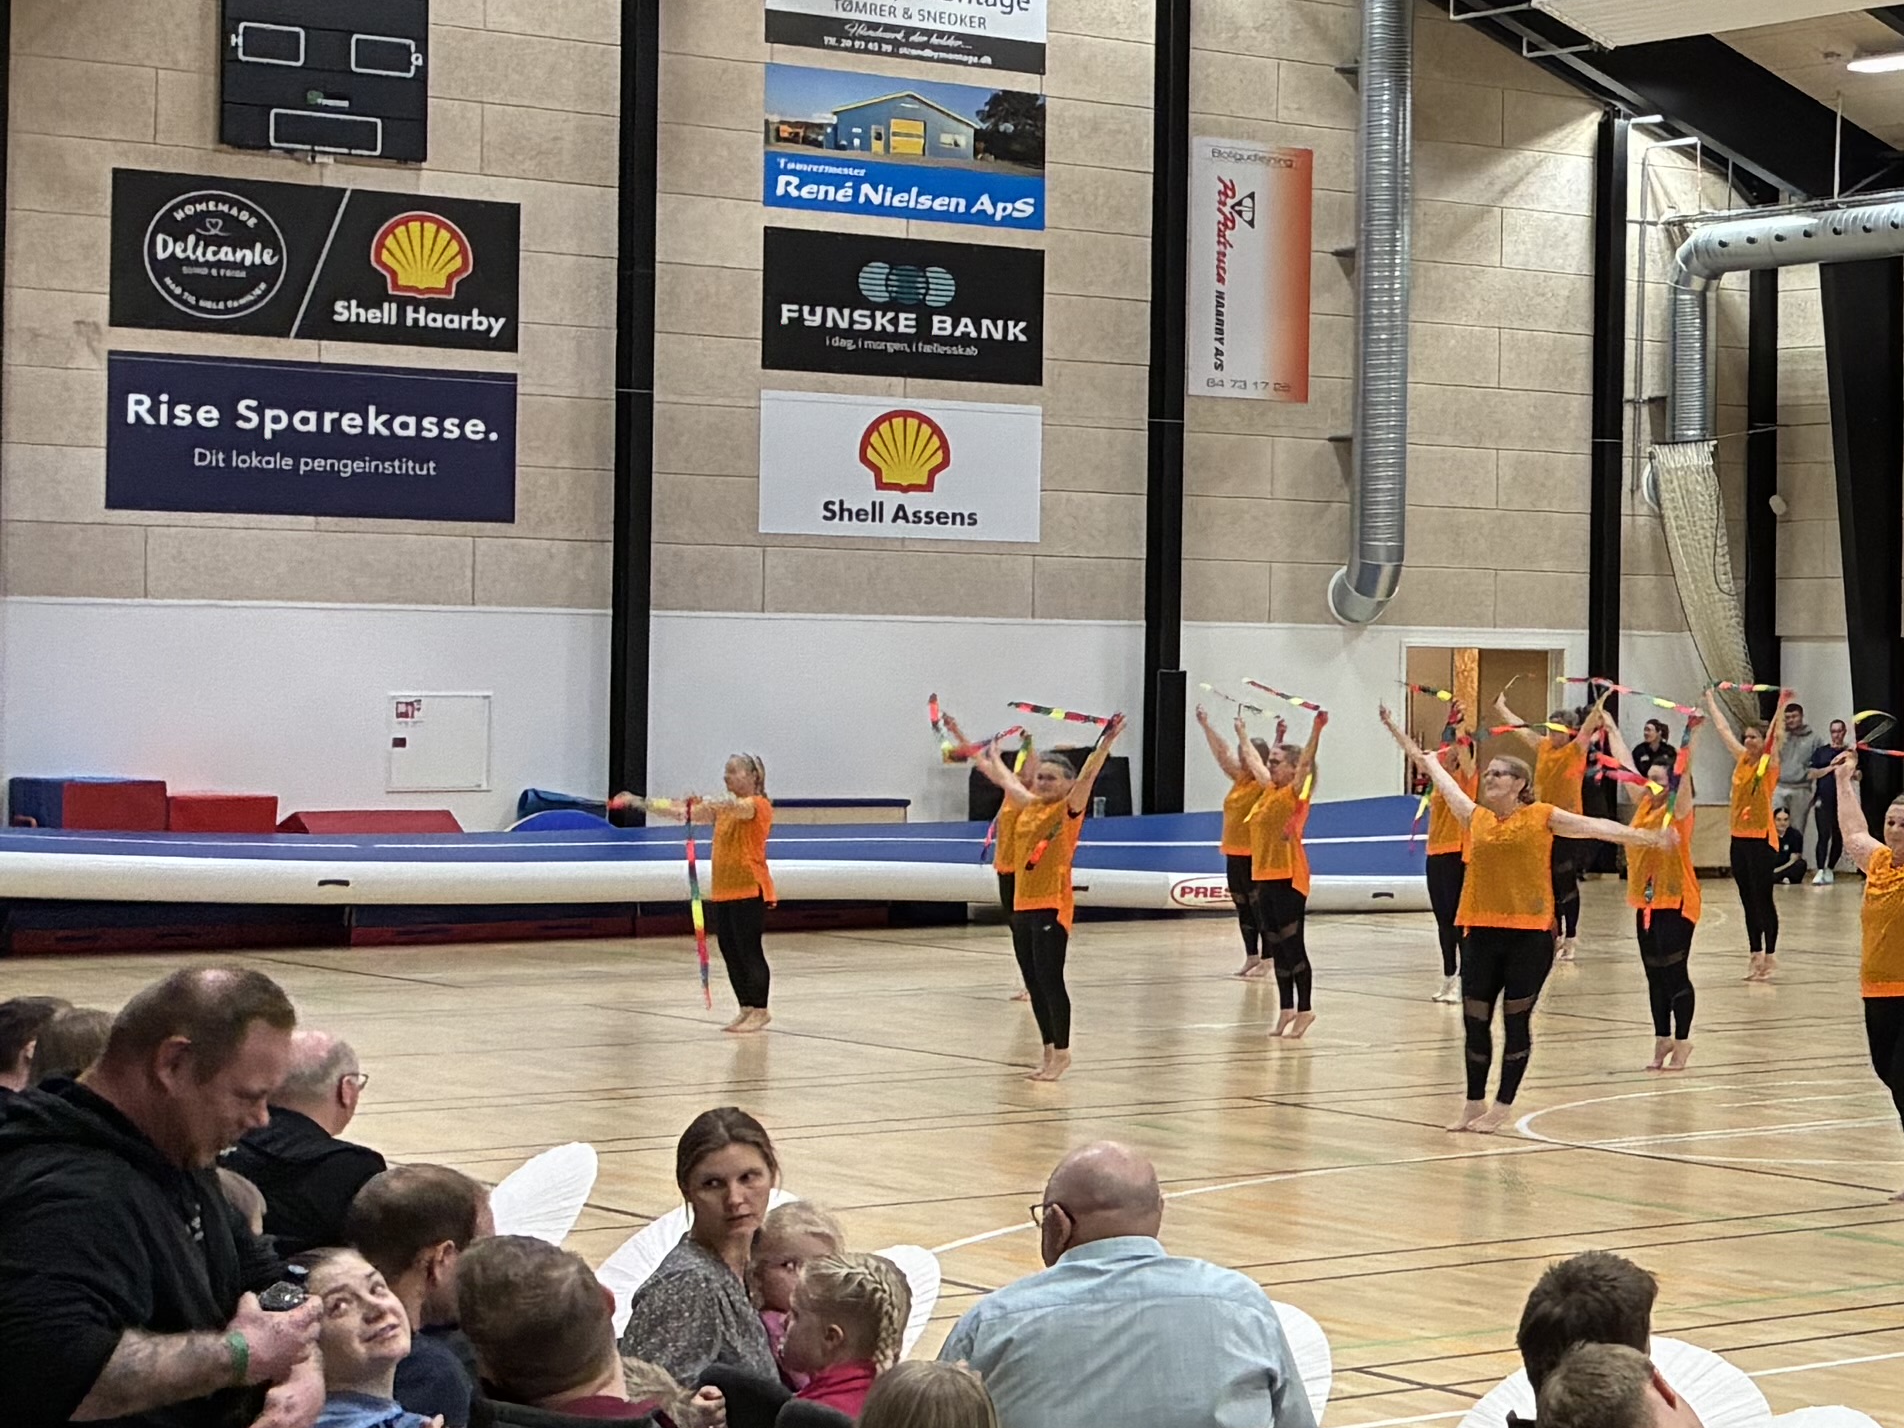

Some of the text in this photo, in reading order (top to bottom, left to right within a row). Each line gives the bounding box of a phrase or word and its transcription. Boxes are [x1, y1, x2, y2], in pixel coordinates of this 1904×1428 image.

[902, 7, 913, 21] &
[918, 9, 987, 31] SNEDKER
[173, 200, 259, 229] HOMEMADE
[775, 174, 1035, 221] René Nielsen ApS
[333, 299, 507, 338] Shell Haarby
[780, 303, 1028, 342] FYNSKE BANK
[126, 393, 500, 442] Rise Sparekasse.
[193, 448, 437, 478] Dit lokale pengeinstitut
[822, 498, 979, 527] Shell Assens
